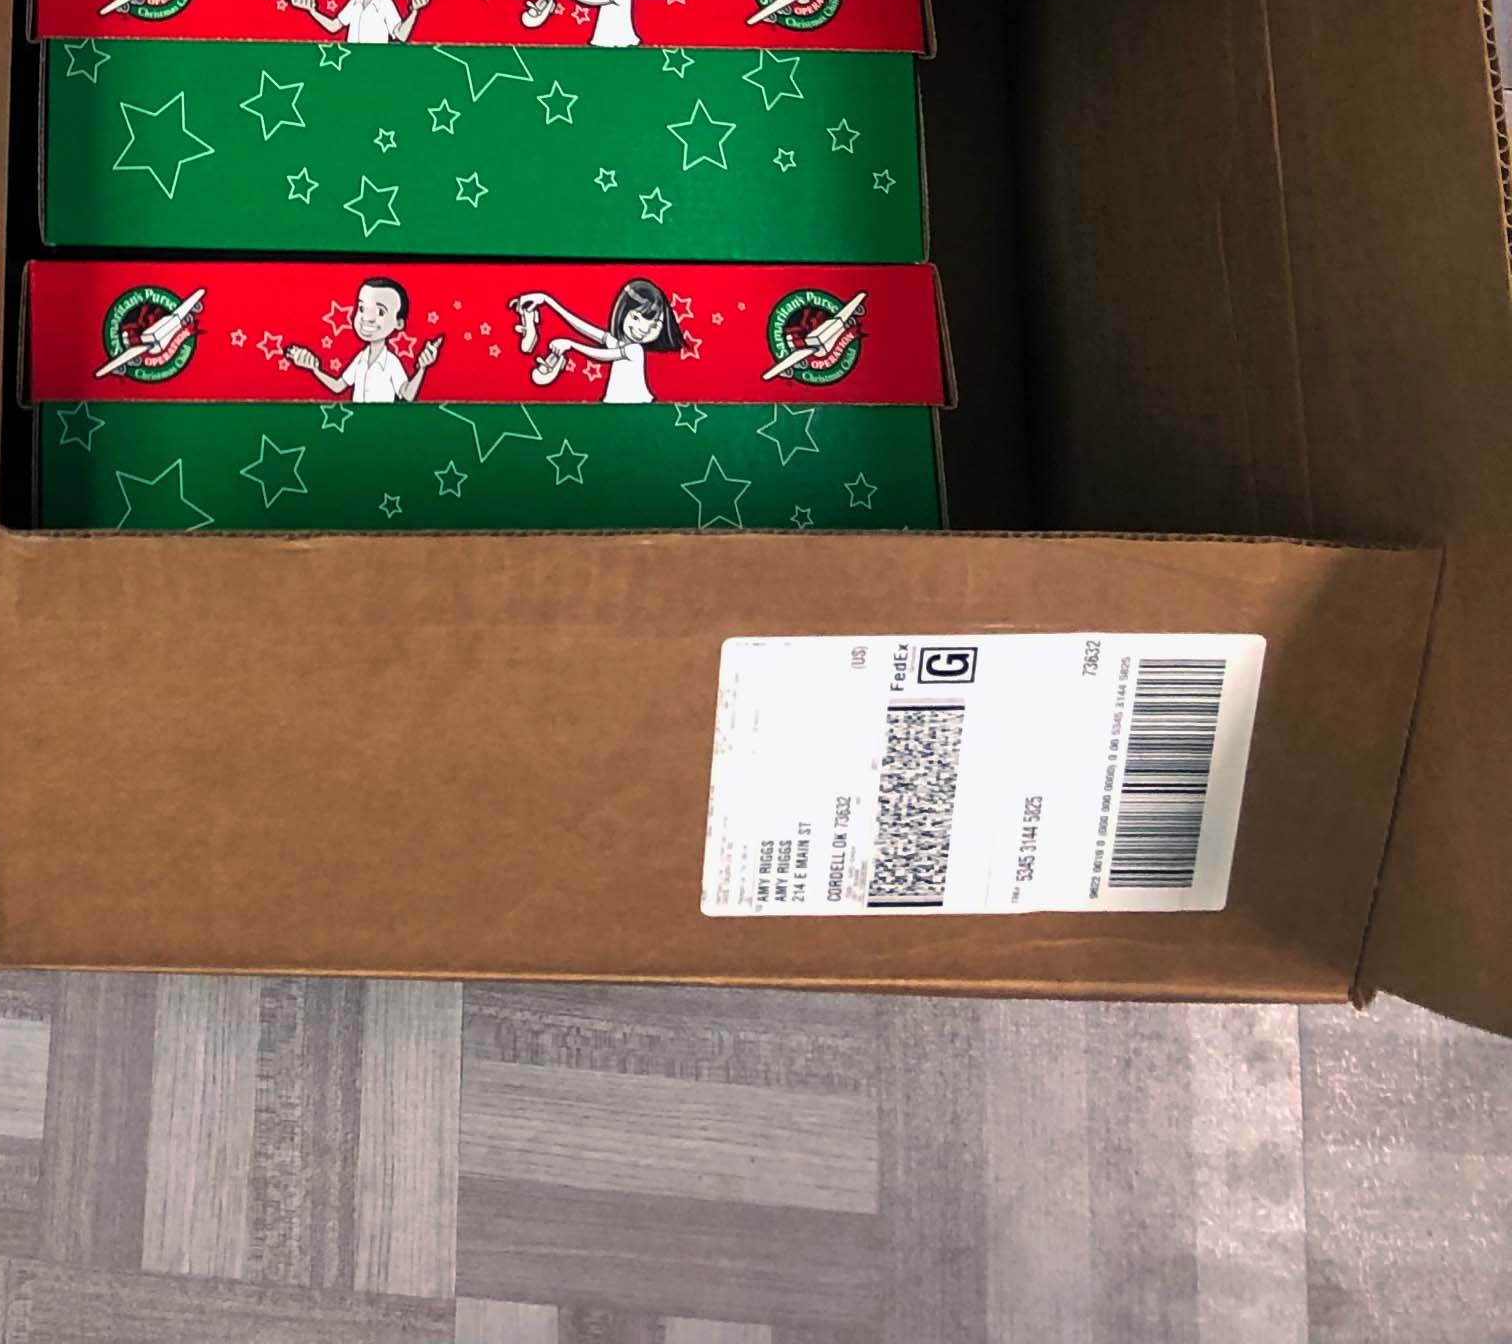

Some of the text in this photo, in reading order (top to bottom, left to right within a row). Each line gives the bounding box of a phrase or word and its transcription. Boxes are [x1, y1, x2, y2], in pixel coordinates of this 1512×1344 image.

[144, 287, 178, 311] Purse
[806, 291, 840, 313] Purse
[144, 327, 191, 367] OPERATION
[810, 331, 855, 369] OPERATION
[851, 646, 868, 669] (US)
[890, 643, 909, 691] FedEx
[1082, 640, 1101, 676] 73632
[1023, 796, 1043, 822] 5825
[798, 822, 811, 835] ST
[1019, 826, 1038, 852] 3144
[759, 840, 774, 874] RIGGS
[796, 840, 810, 869] MAIN
[827, 796, 851, 902] CORDELL OK 73632
[775, 840, 792, 902] AMY RIGGS
[1016, 855, 1035, 881] 5345
[757, 877, 770, 902] AMY
[792, 883, 806, 902] 214
